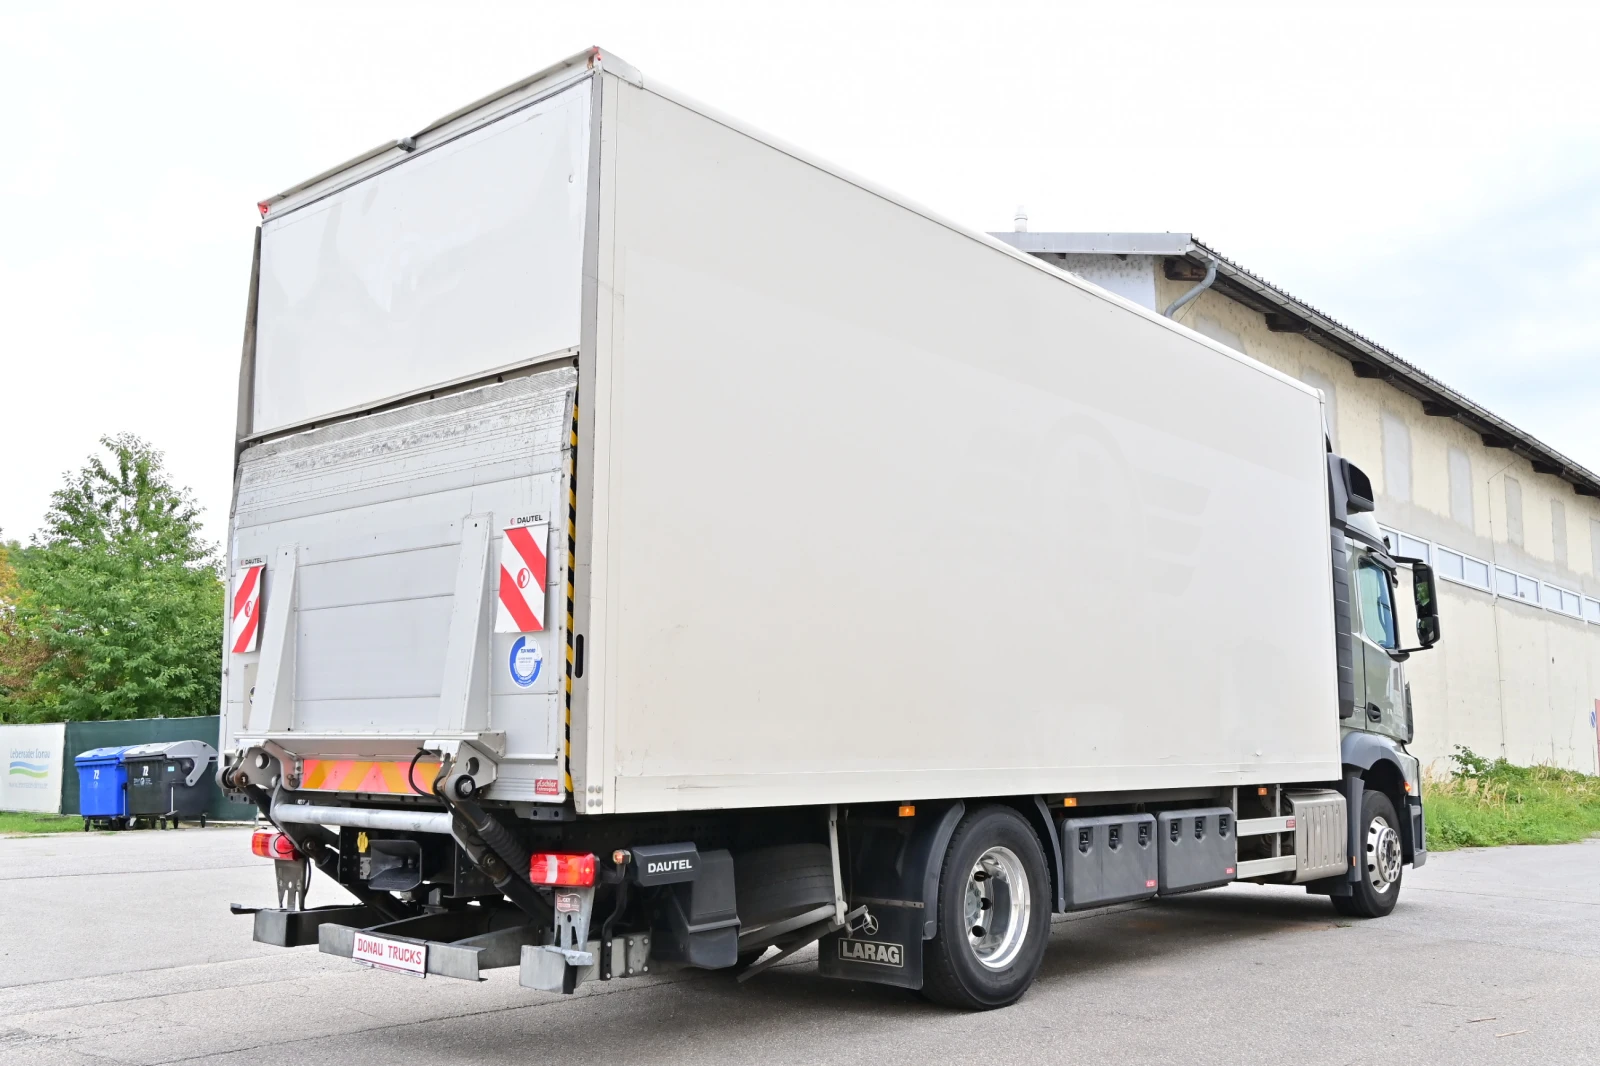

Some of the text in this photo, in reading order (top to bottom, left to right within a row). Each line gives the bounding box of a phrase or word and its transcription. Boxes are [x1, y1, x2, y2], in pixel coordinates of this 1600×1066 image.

[517, 515, 543, 524] DAUTEL
[93, 769, 100, 780] 72
[142, 765, 149, 777] 72
[647, 859, 692, 873] DAUTEL
[357, 938, 422, 965] DONAU TRUCKS
[842, 941, 900, 964] LARAG
